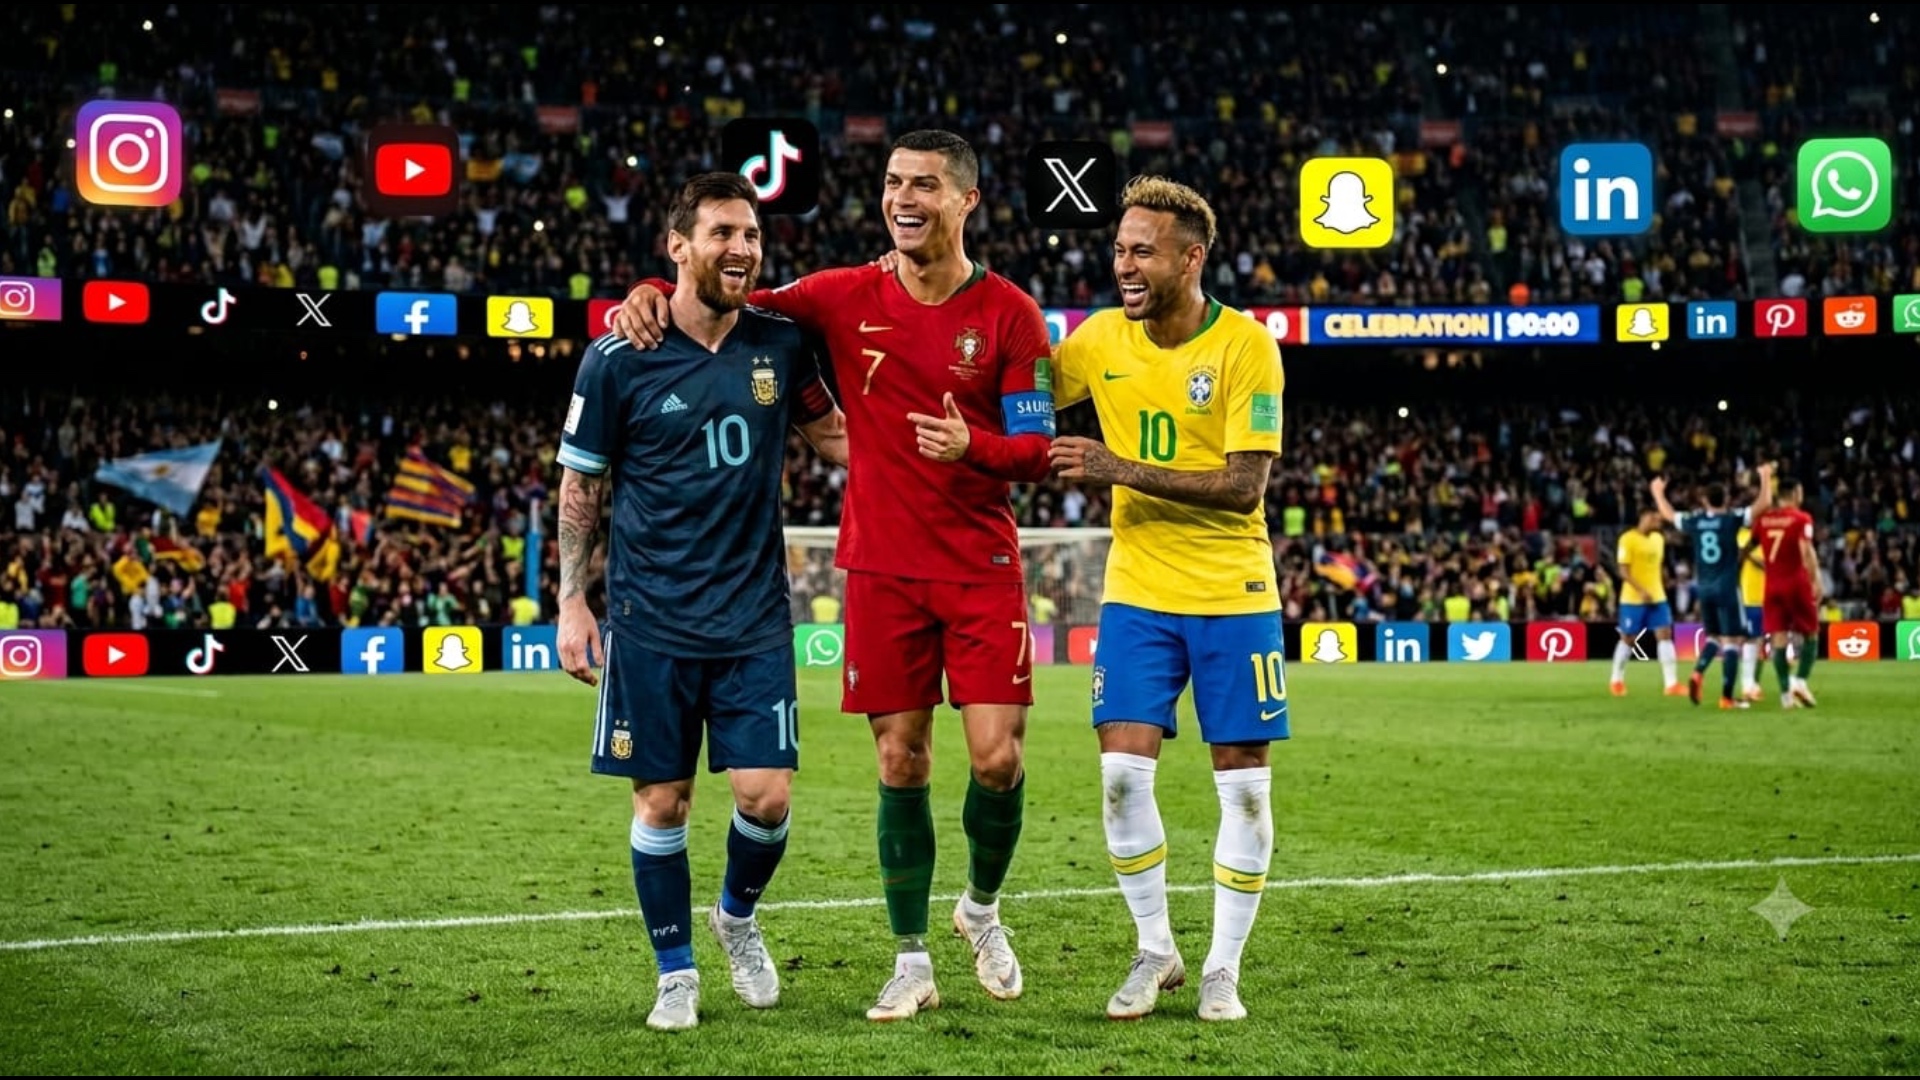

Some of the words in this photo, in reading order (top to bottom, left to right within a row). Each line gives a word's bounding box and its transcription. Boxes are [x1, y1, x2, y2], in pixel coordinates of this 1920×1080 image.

[296, 294, 332, 327] X
[404, 300, 430, 335] f
[1324, 313, 1489, 337] CELEBRATION
[1506, 311, 1579, 337] 90:00
[1696, 306, 1727, 334] in
[862, 349, 886, 395] 7
[701, 414, 750, 469] 10
[1139, 409, 1177, 462] 10
[1701, 530, 1721, 564] 8
[1767, 529, 1785, 562] 7
[270, 635, 310, 672] X
[360, 636, 385, 674] f
[511, 633, 550, 669] in
[1011, 621, 1026, 666] 7
[1384, 628, 1420, 662] in
[1250, 651, 1287, 702] 10
